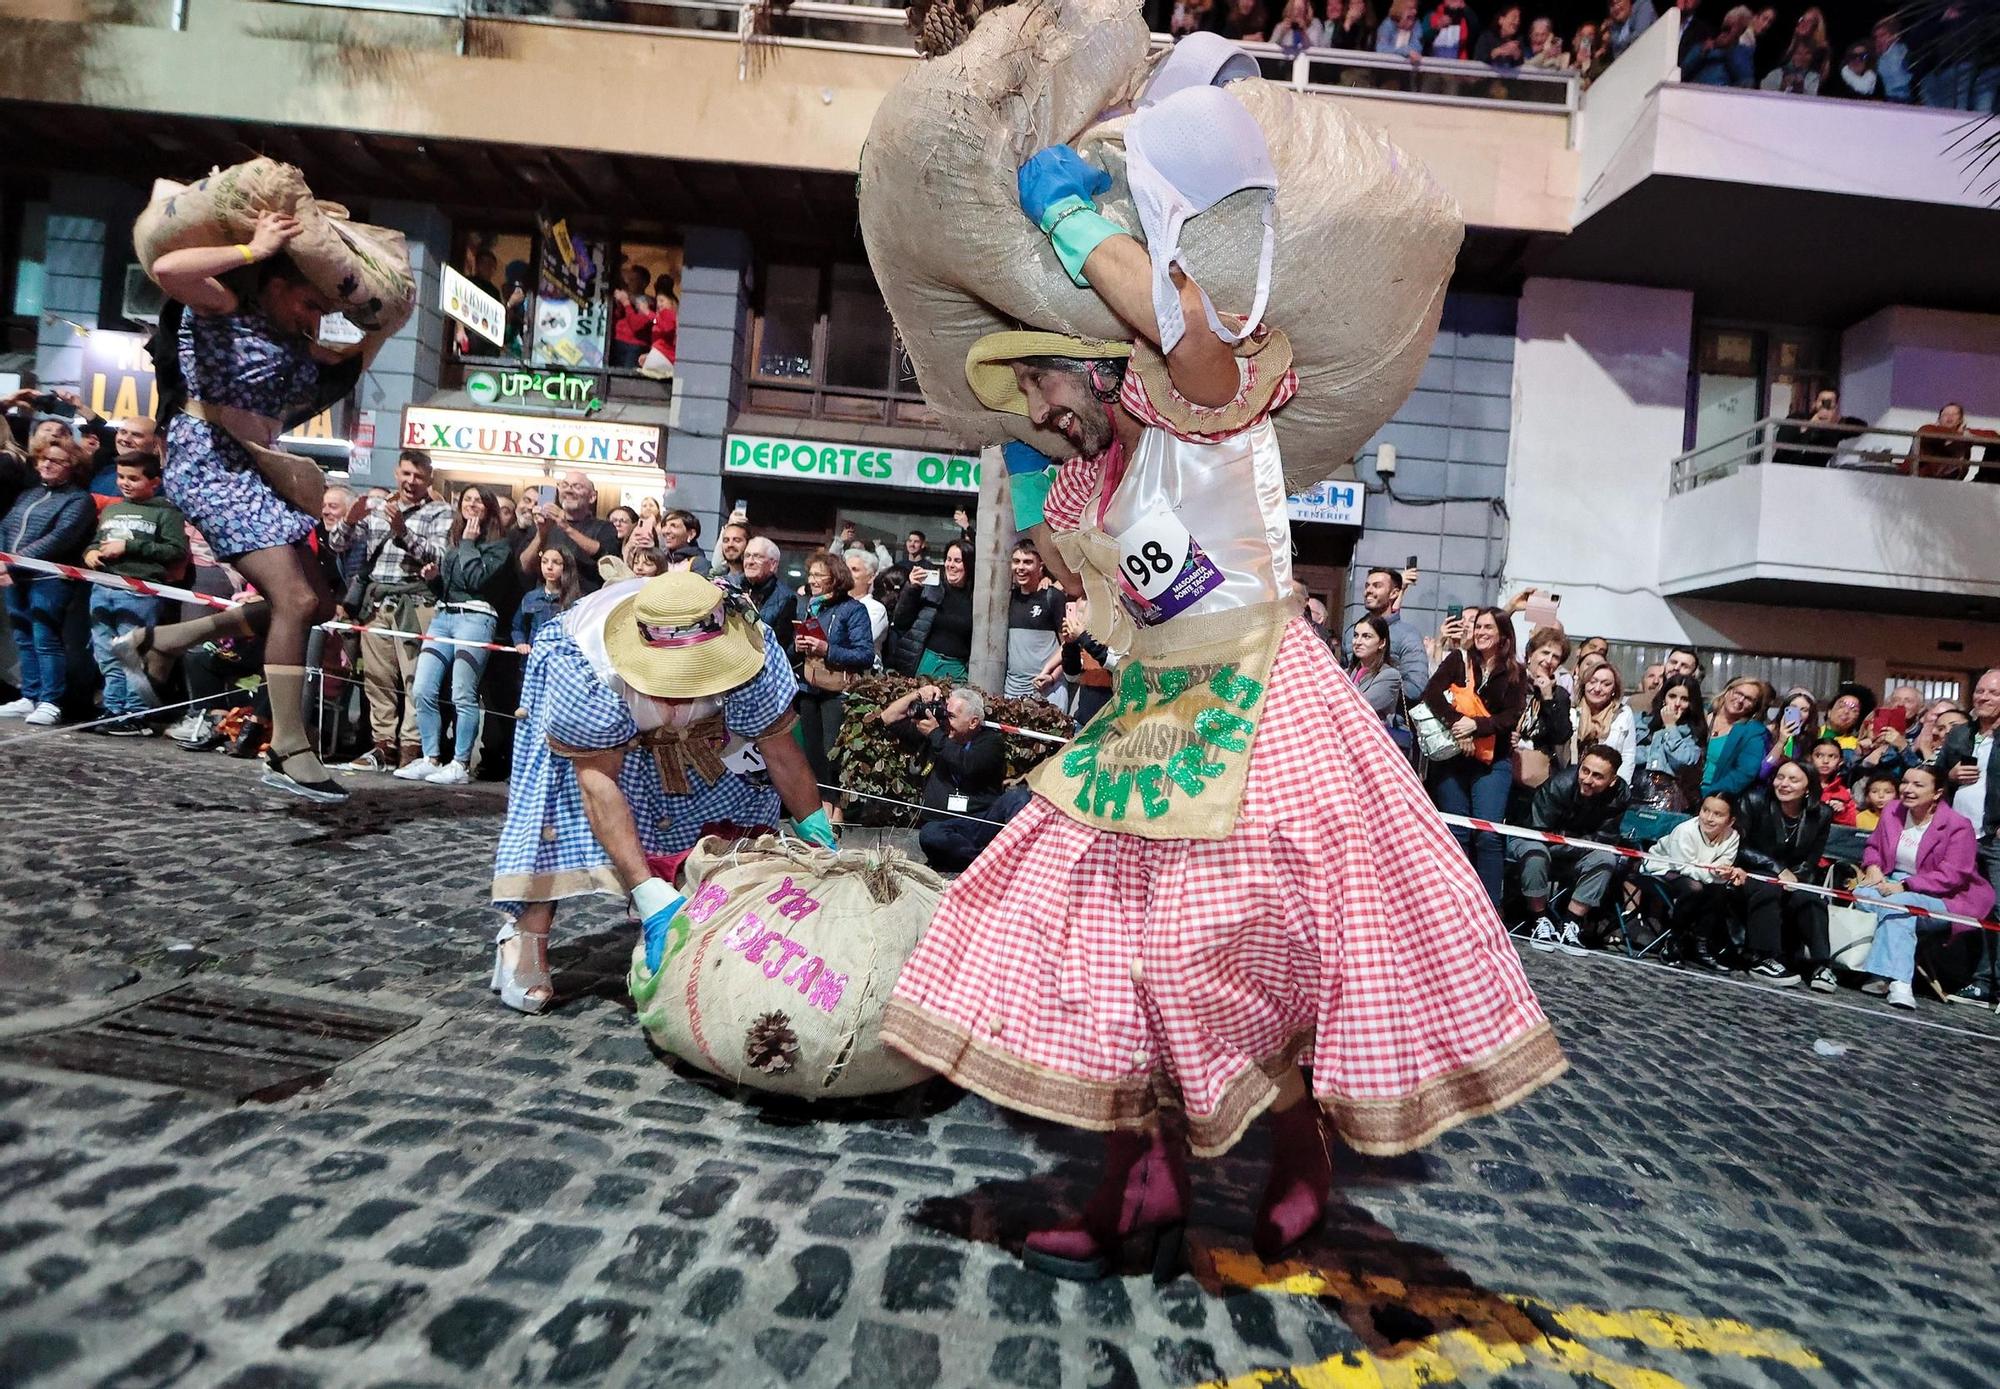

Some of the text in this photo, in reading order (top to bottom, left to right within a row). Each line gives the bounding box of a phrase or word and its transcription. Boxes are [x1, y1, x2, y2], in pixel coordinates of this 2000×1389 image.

[406, 421, 657, 464] EXCURSIONES
[729, 440, 893, 479] DEPORTES
[1296, 509, 1351, 521] TENERIFE
